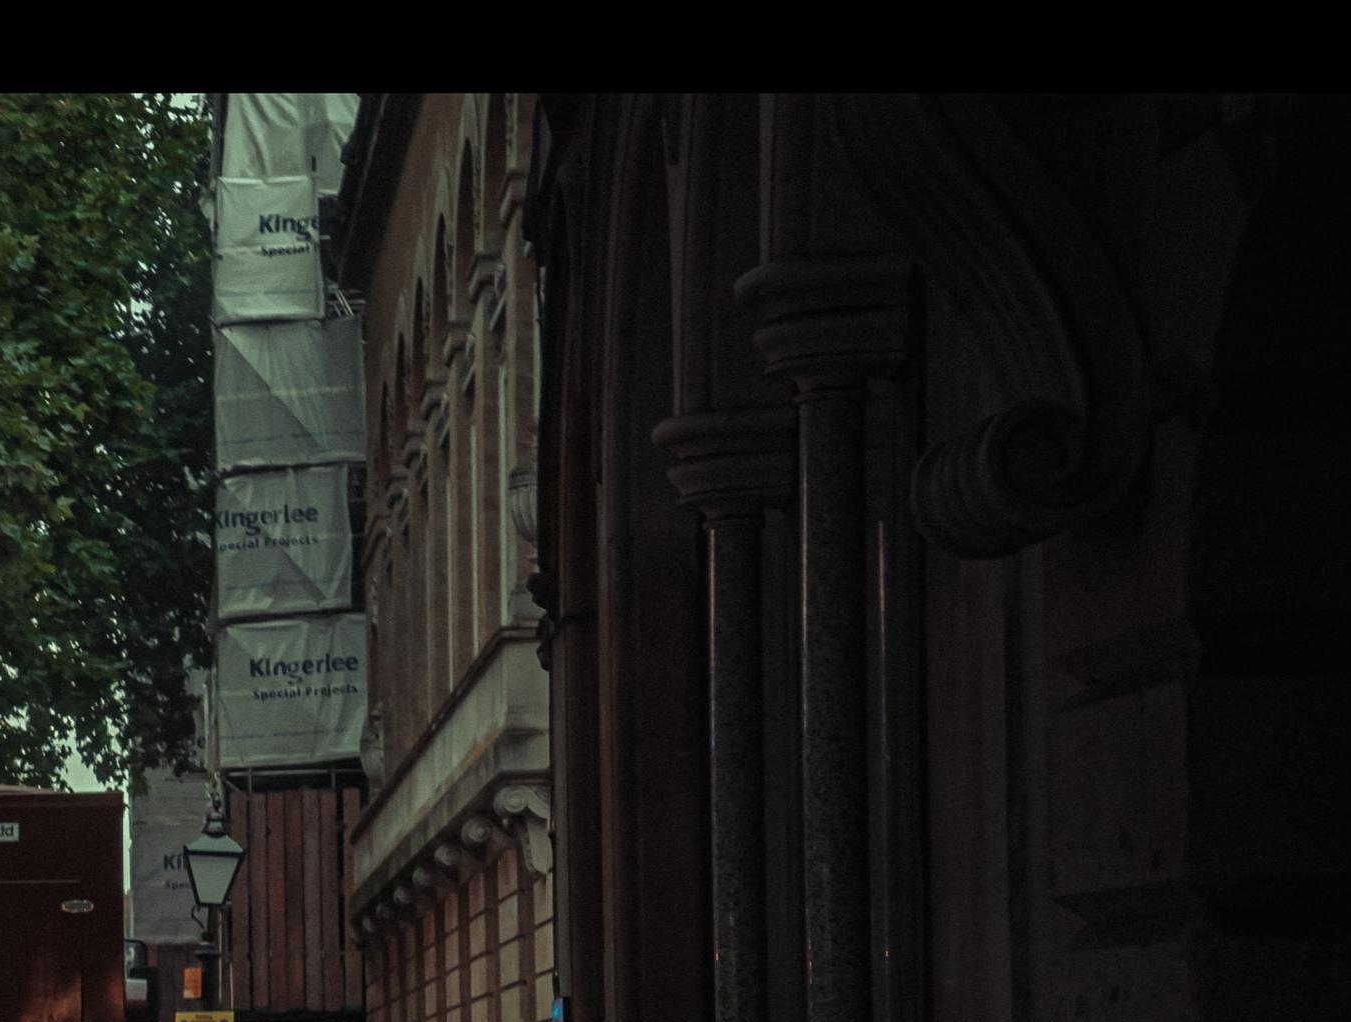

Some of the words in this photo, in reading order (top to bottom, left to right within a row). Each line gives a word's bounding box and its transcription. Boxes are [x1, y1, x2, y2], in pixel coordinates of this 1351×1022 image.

[215, 537, 259, 552] pecial
[263, 535, 319, 548] Projects
[249, 653, 359, 685] Kingerlee
[253, 688, 301, 702] Special
[305, 684, 359, 698] Projects
